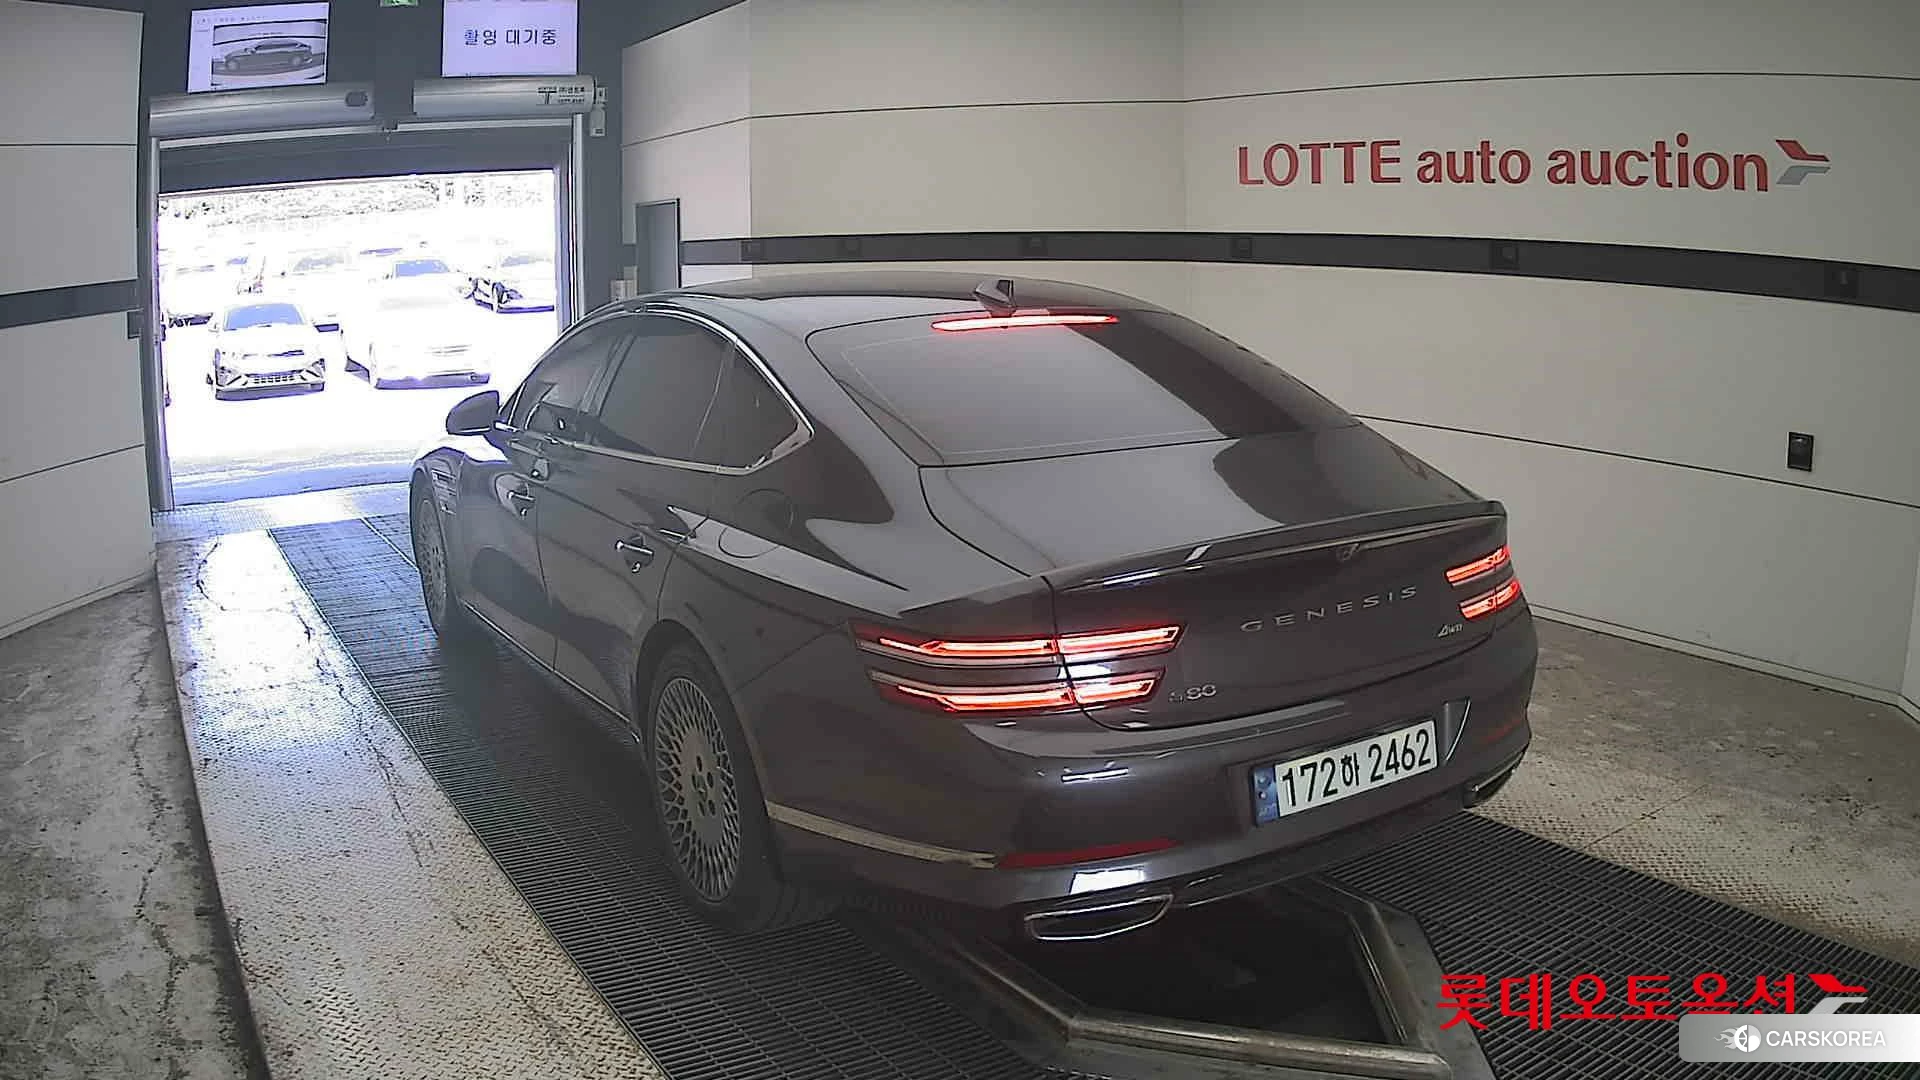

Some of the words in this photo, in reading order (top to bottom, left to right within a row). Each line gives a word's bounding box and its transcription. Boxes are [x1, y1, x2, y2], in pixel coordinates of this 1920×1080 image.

[505, 29, 557, 45] 대기중
[1238, 140, 1402, 187] LOTTE
[1415, 141, 1532, 184] auto
[1546, 132, 1769, 192] auction
[1240, 586, 1417, 632] GENESIS
[1282, 753, 1360, 807] 172하
[1368, 728, 1431, 783] 2462
